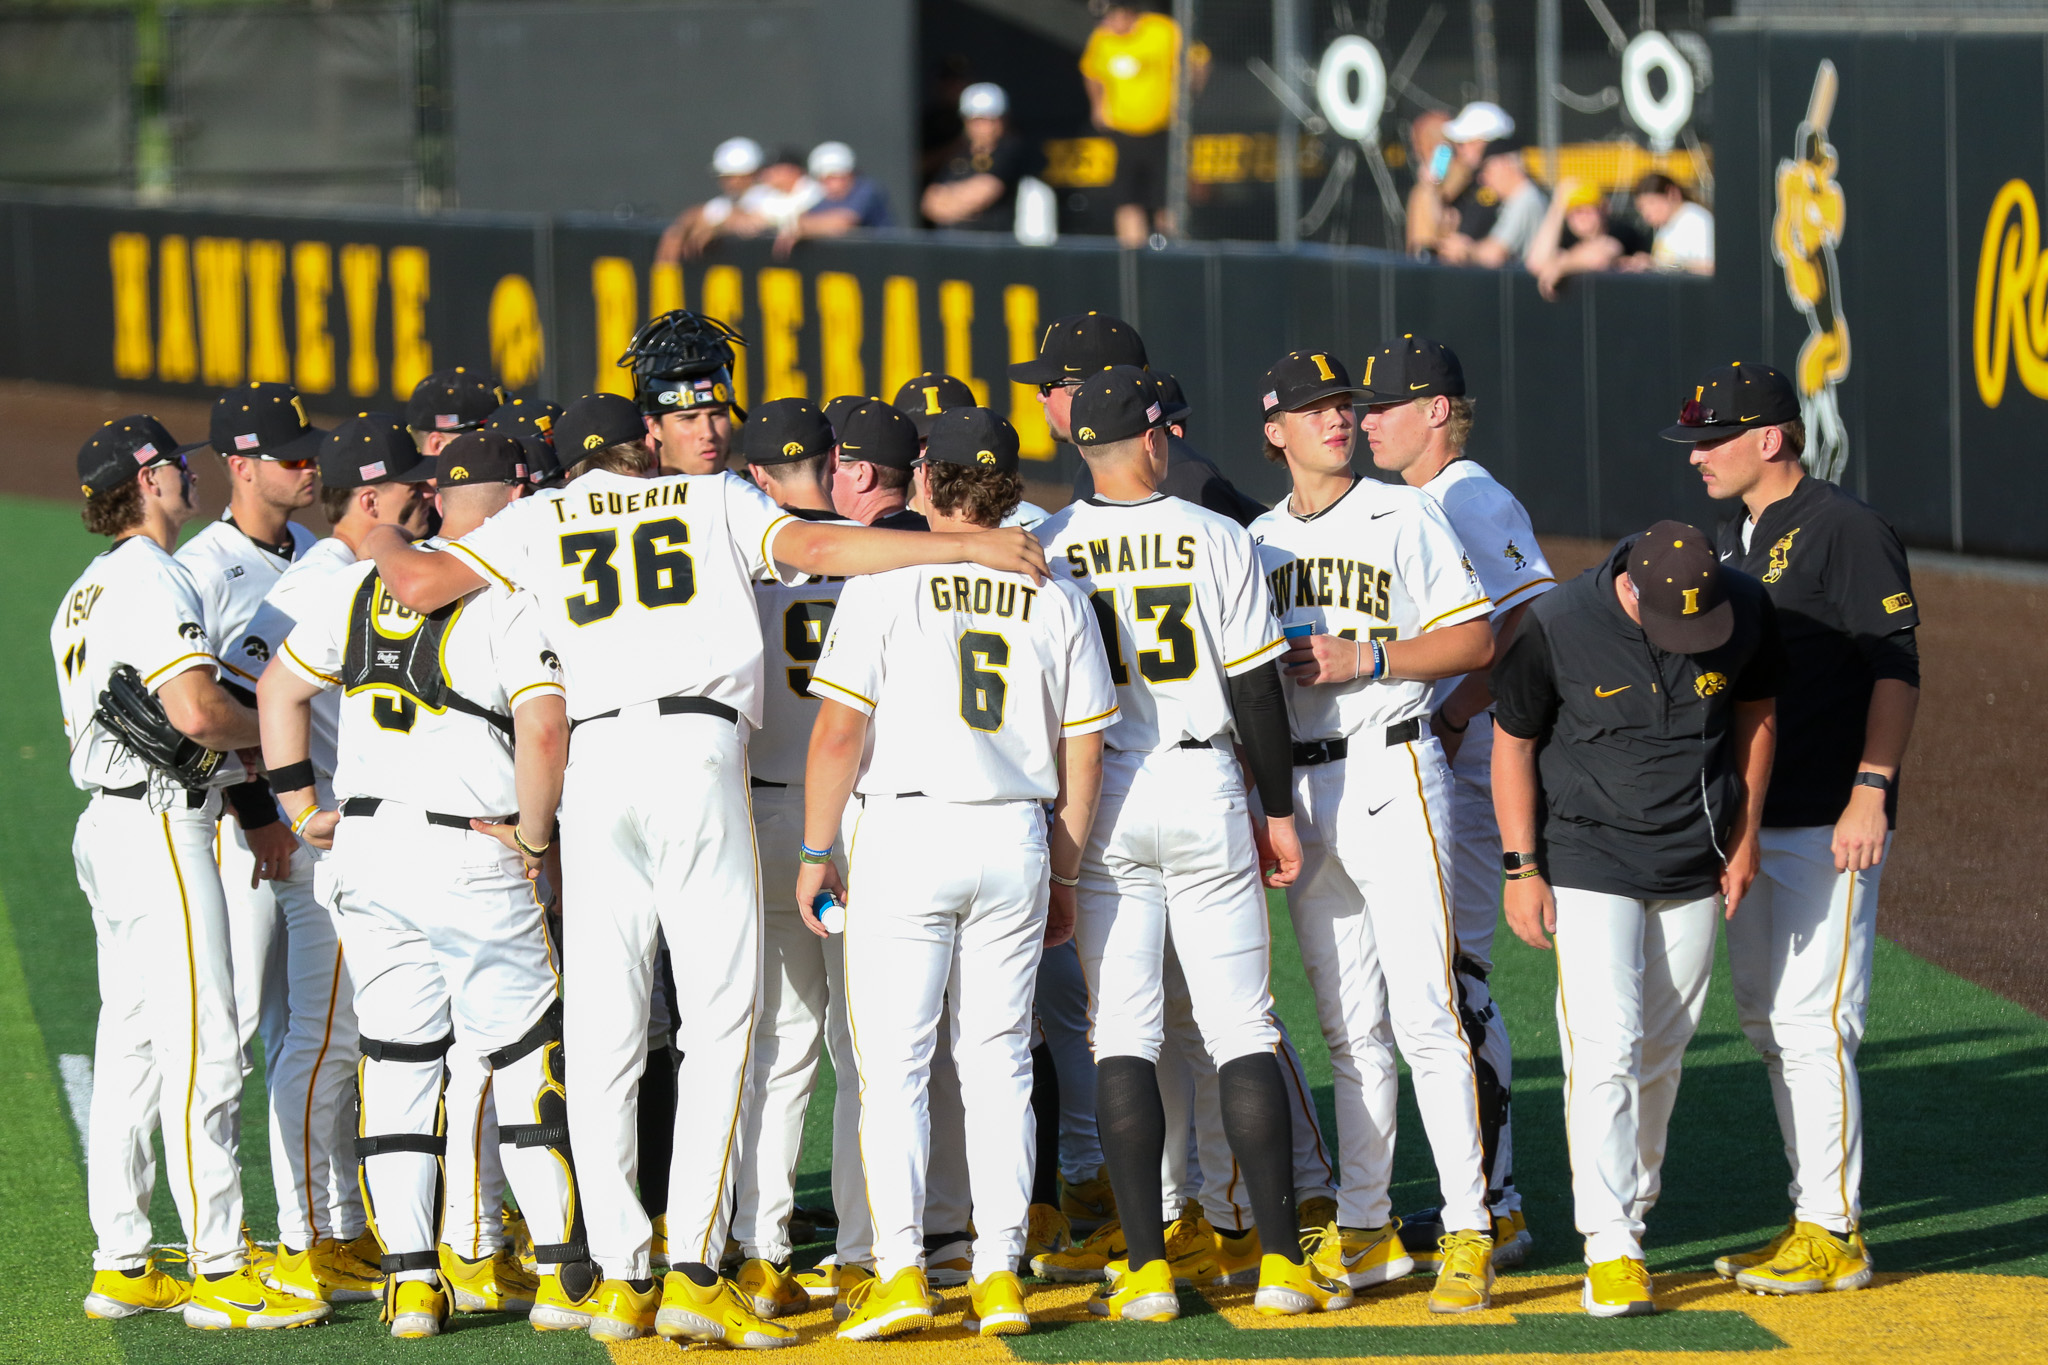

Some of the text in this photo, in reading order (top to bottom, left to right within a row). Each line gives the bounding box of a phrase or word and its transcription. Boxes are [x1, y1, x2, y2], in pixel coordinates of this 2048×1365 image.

[110, 232, 432, 401] HAWKEYE
[1973, 178, 2048, 408] R
[1311, 354, 1336, 381] I
[921, 386, 943, 415] I
[550, 482, 689, 523] T. GUERIN
[559, 515, 697, 628] 36
[1067, 534, 1196, 579] SWAILS
[930, 575, 1038, 623] GROUT
[1681, 588, 1700, 615] I
[1089, 583, 1199, 686] 13
[958, 628, 1011, 733] 6
